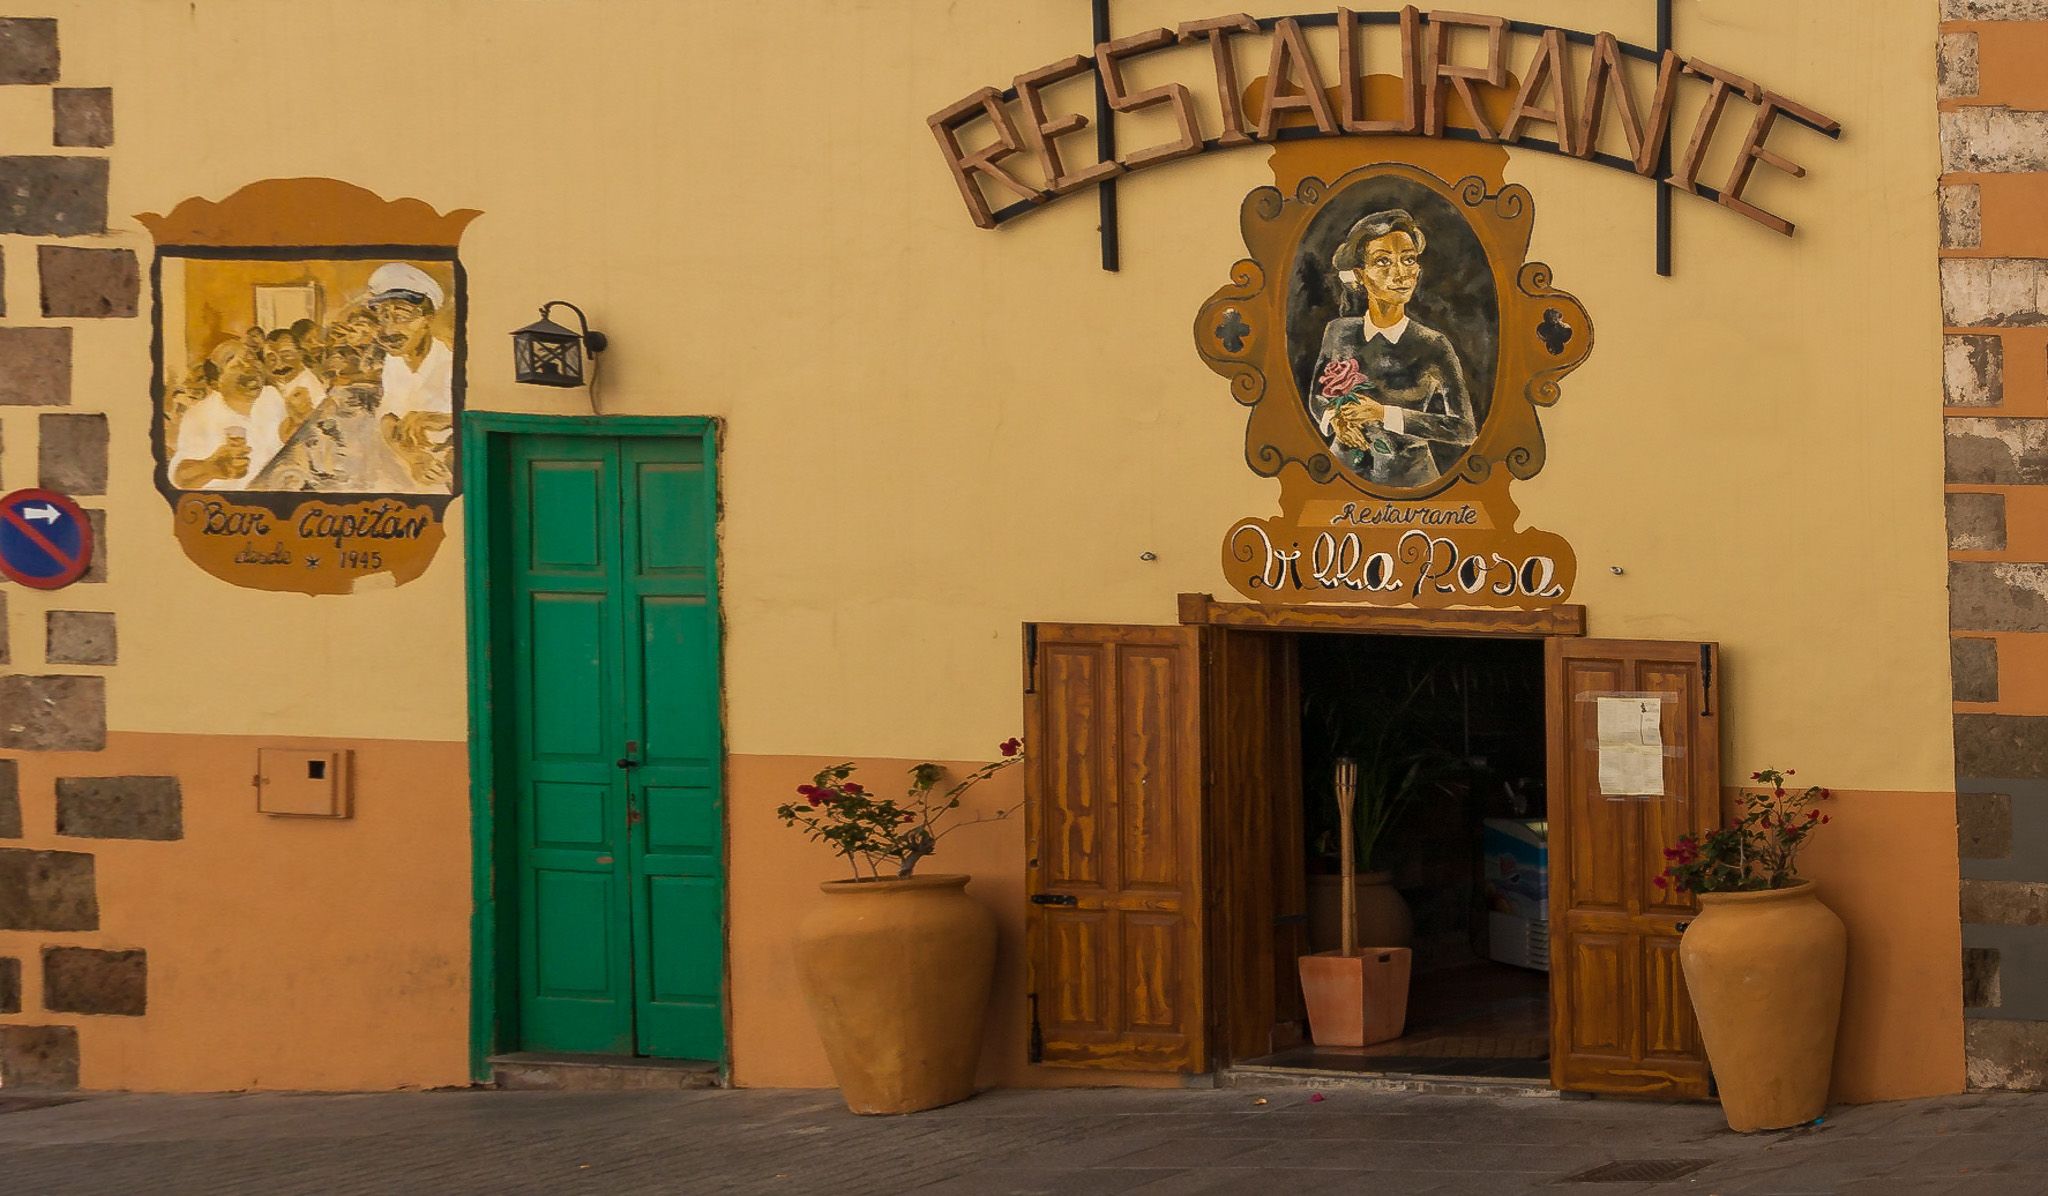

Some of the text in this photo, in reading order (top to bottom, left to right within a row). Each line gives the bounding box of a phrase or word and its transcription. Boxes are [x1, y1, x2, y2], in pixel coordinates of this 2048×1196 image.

[927, 5, 1842, 238] RESTAURANTE
[188, 500, 428, 548] Bar Capitán
[338, 550, 383, 569] 1945
[1231, 525, 1565, 599] Villa Rosa
